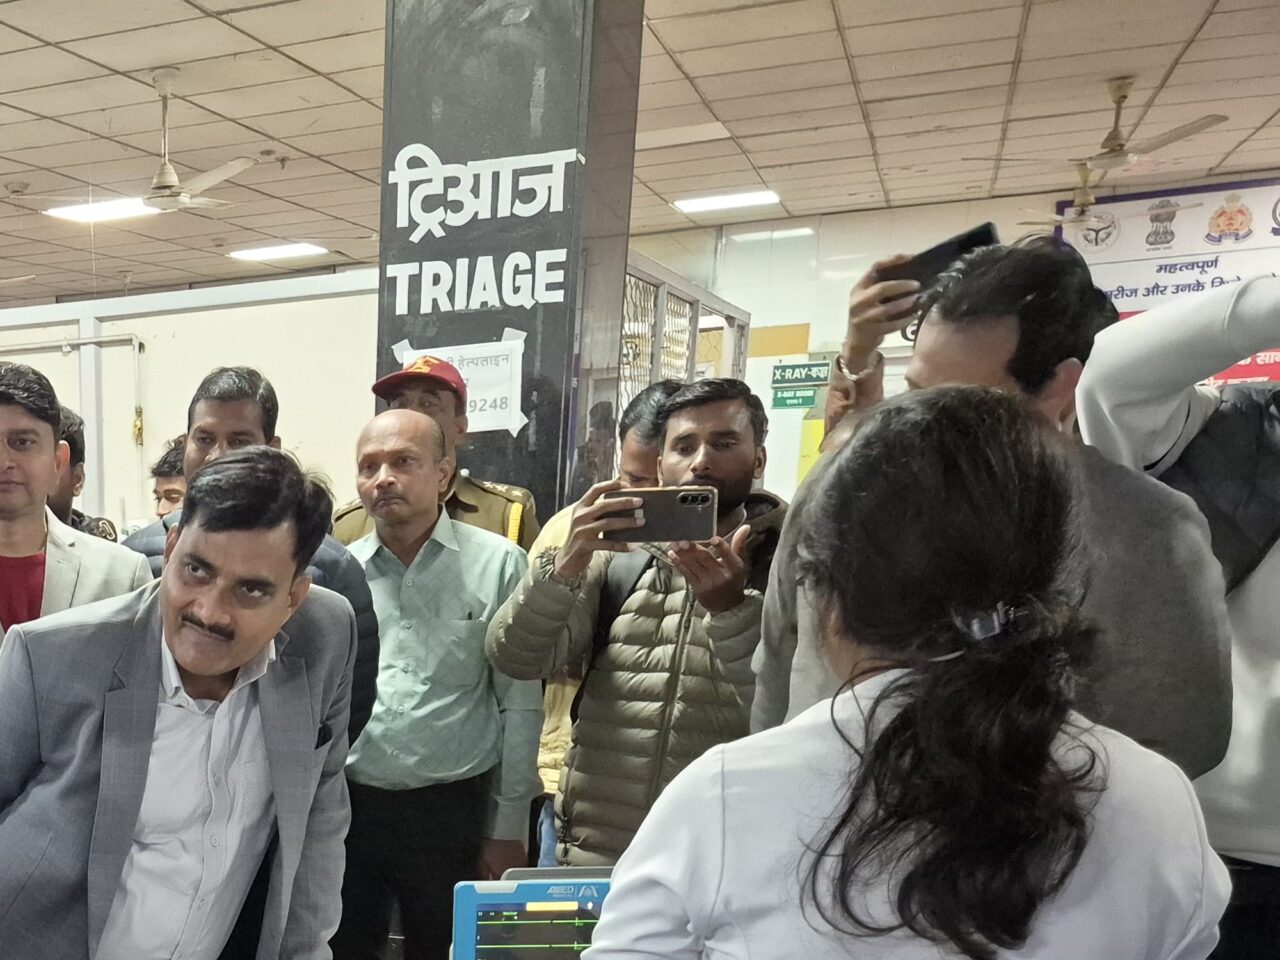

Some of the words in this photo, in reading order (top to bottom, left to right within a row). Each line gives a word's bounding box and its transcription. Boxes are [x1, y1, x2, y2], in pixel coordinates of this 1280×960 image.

[1155, 254, 1220, 275] महत्वपूर्ण
[386, 248, 568, 316] TRIAGE
[1142, 281, 1169, 298] और
[1171, 278, 1207, 294] उनके
